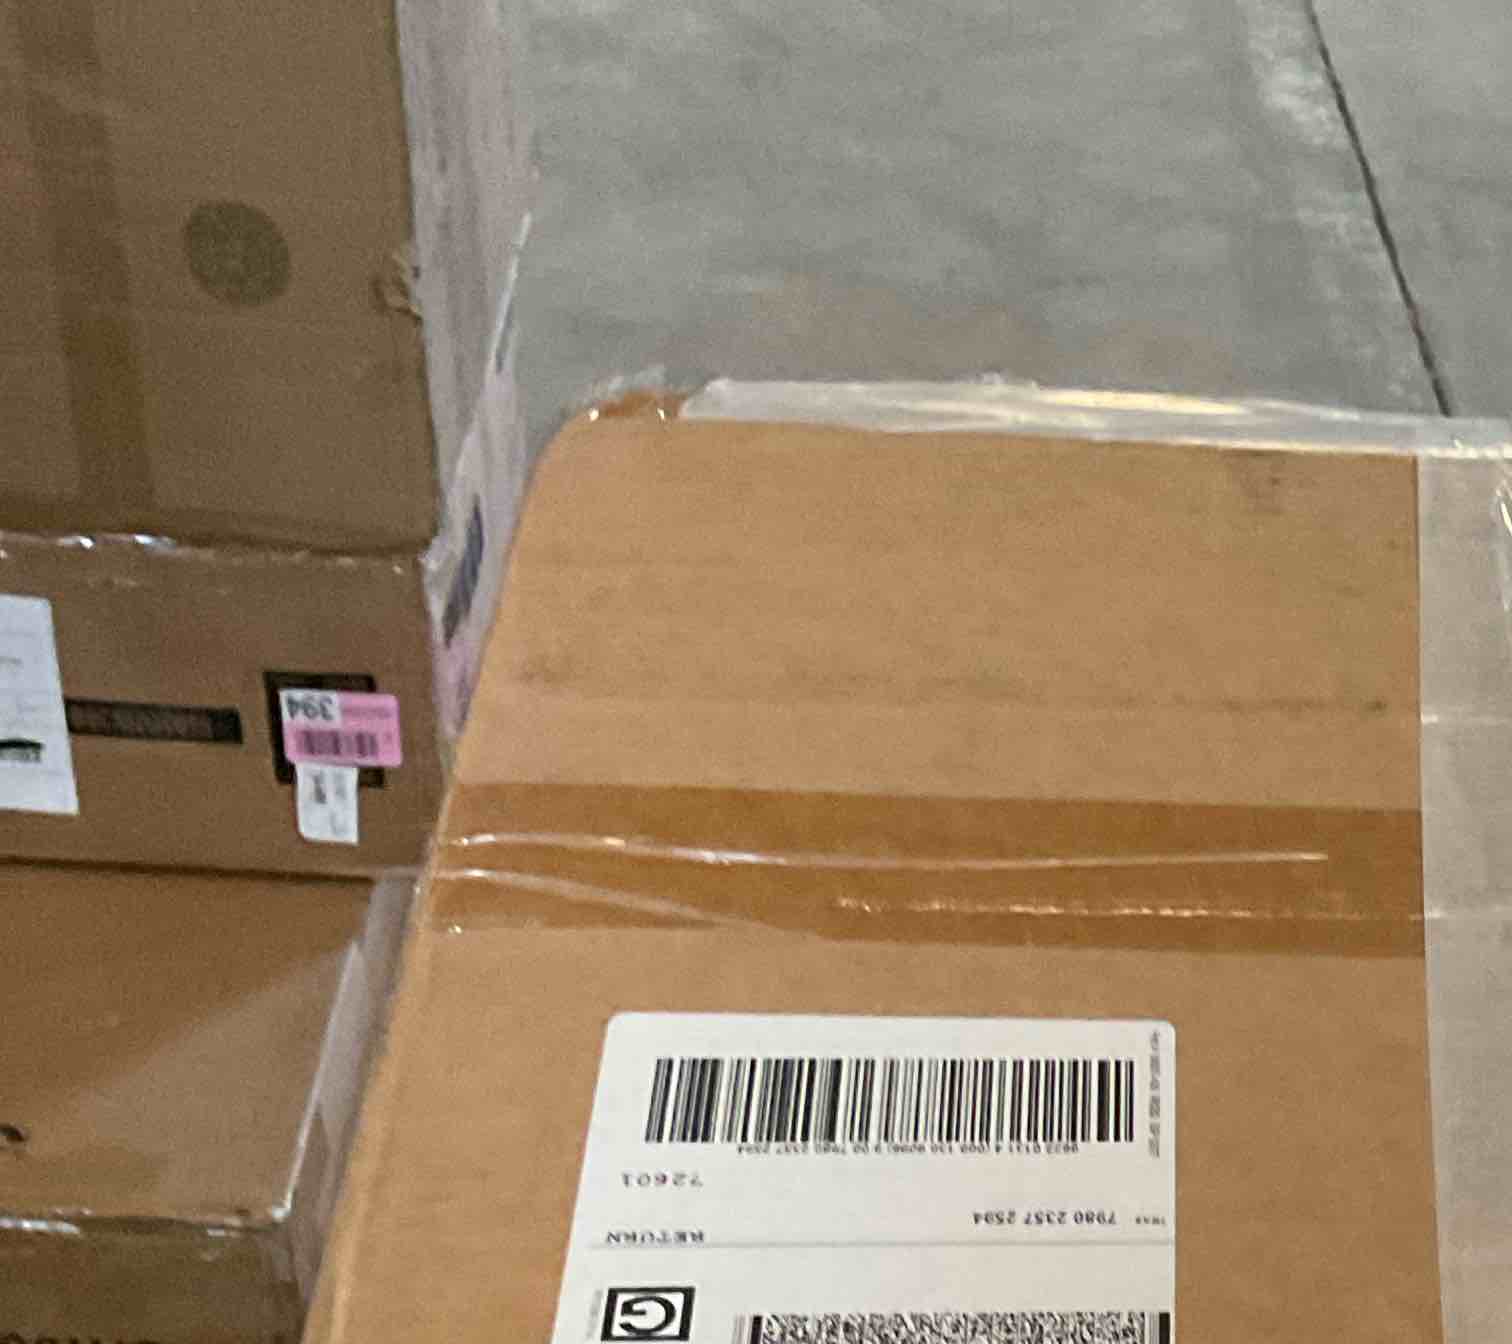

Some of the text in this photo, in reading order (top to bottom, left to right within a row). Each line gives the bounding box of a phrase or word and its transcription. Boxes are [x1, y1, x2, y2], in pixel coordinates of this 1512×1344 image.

[286, 696, 334, 721] 394
[621, 1172, 705, 1188] 72601
[972, 1209, 1017, 1226] 2594
[1023, 1210, 1069, 1227] 2357
[1072, 1209, 1118, 1226] 7980
[606, 1230, 705, 1244] RETURN
[619, 1296, 677, 1336] G
